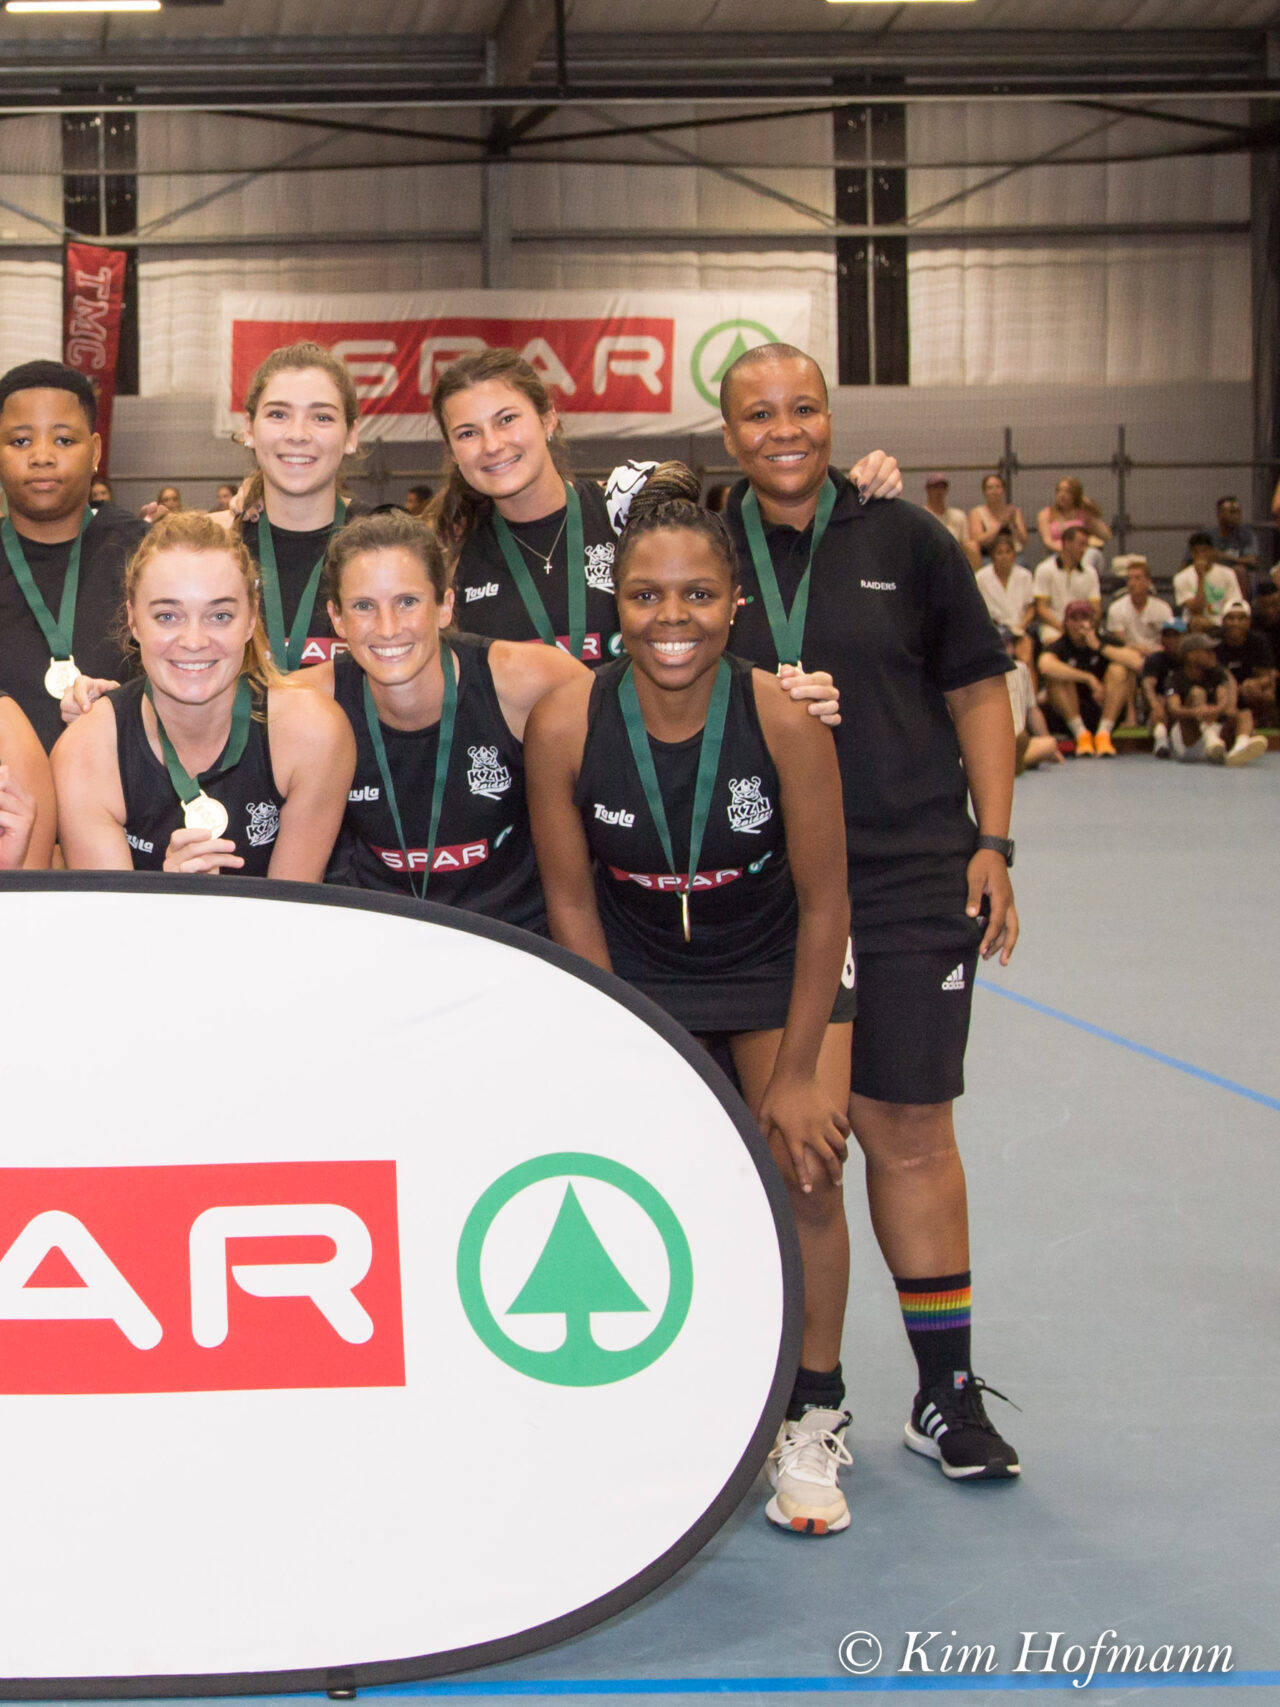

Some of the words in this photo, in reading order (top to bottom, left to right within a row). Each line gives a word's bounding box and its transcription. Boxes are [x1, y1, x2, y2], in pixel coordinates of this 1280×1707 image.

[66, 266, 112, 371] TMC
[860, 579, 897, 591] RAIDERS
[467, 766, 510, 785] KZN
[727, 797, 771, 821] KZN
[381, 843, 487, 870] SPAR
